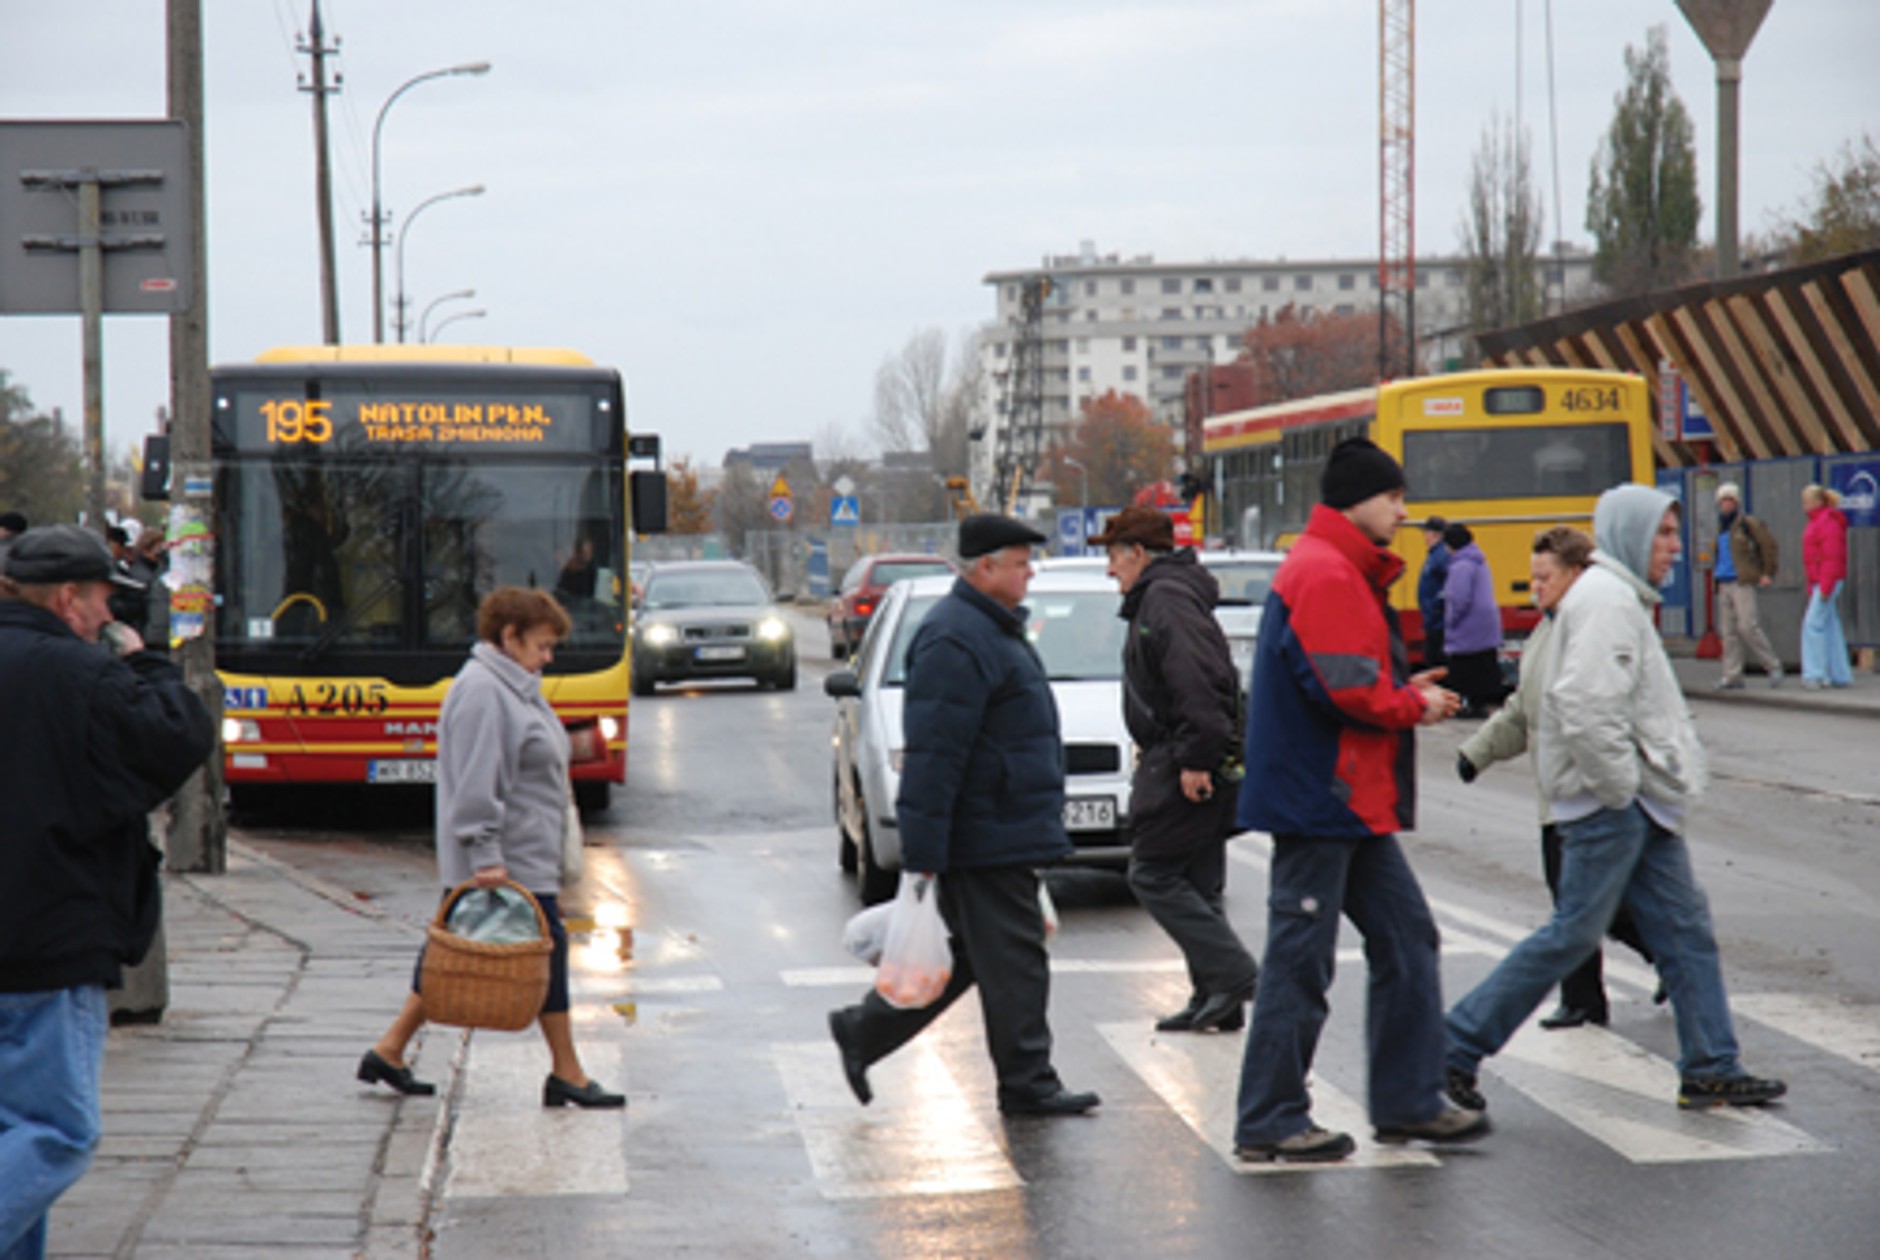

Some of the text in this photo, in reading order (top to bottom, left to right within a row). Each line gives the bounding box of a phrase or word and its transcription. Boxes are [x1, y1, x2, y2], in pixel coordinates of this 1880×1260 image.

[1560, 387, 1619, 412] 4634
[259, 399, 333, 443] 195
[359, 402, 483, 424] NATOLIN
[366, 424, 434, 441] TRASA
[285, 682, 388, 716] A 205
[384, 721, 443, 736] MAN
[1061, 801, 1110, 824] 216
